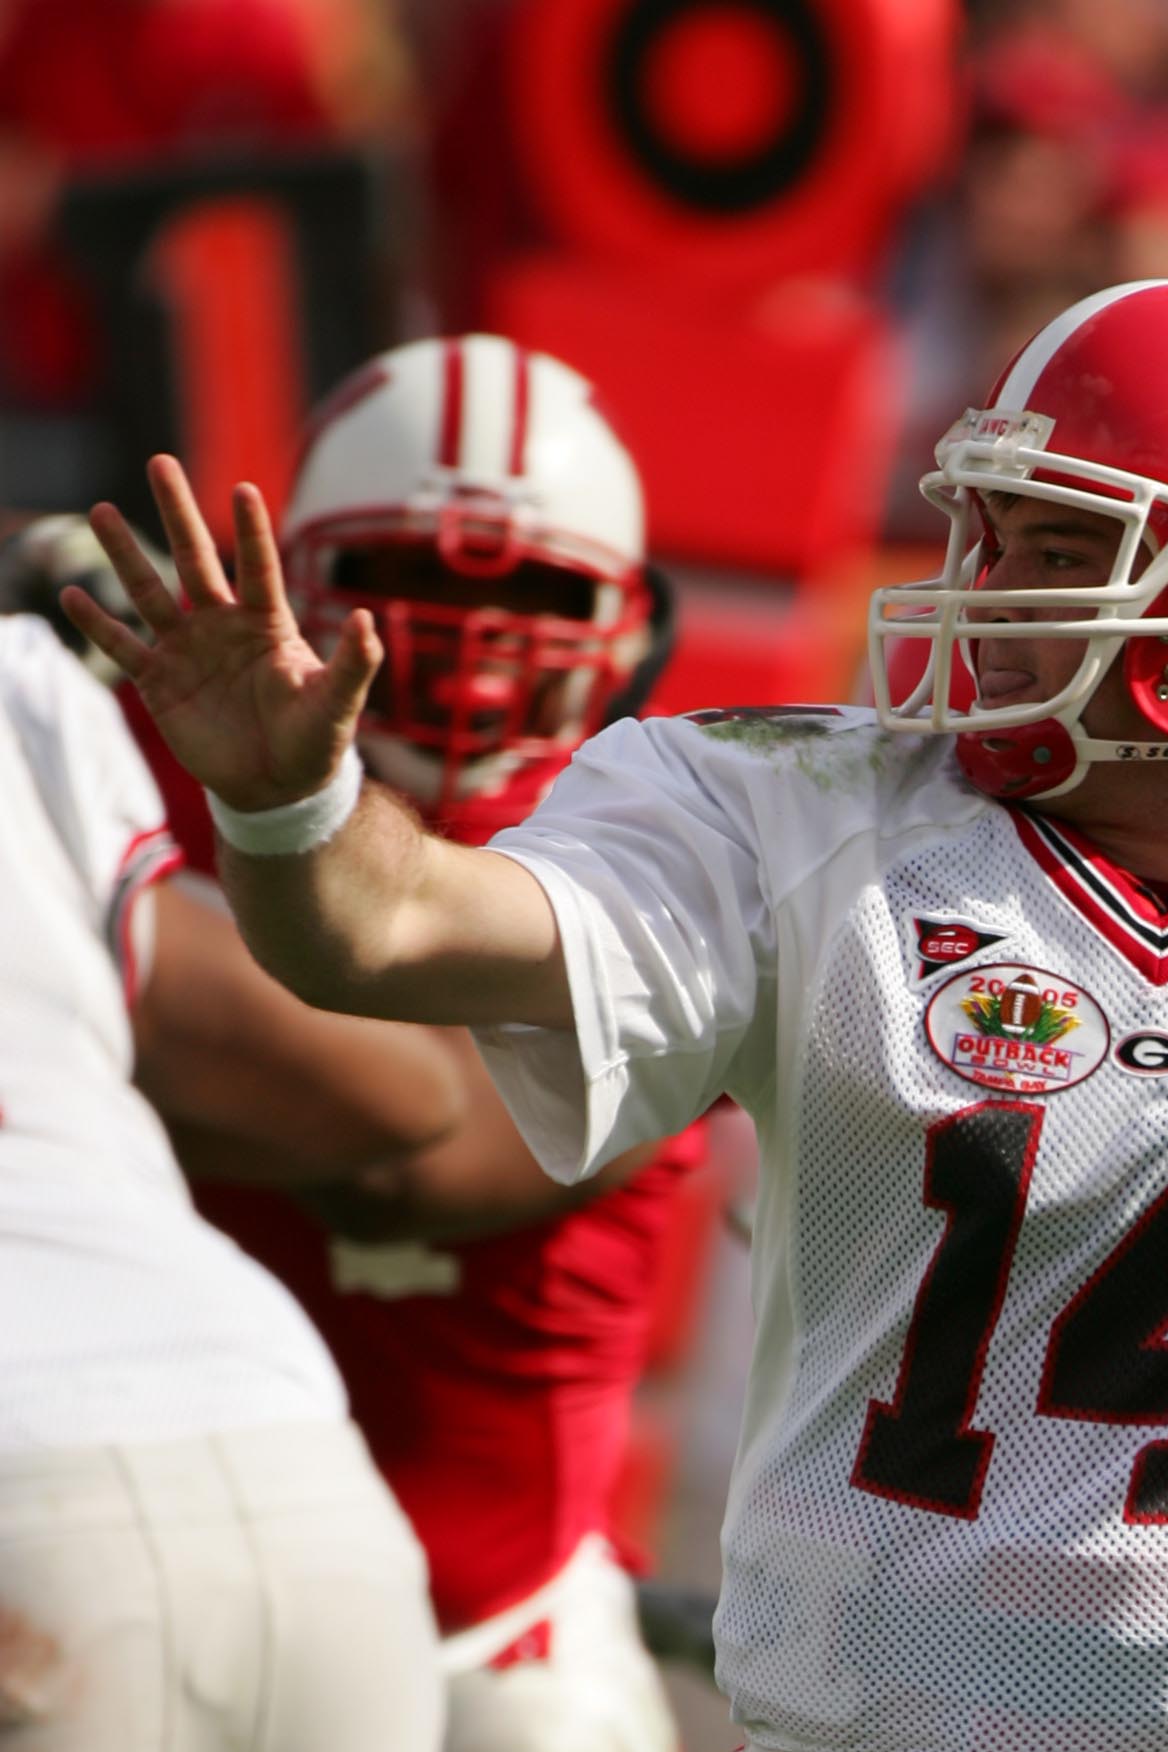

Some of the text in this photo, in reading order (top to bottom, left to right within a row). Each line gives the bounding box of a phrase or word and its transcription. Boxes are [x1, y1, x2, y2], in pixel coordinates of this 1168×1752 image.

[927, 940, 969, 954] SEC
[957, 1036, 1070, 1068] OUTBACK
[971, 1054, 1055, 1077] BOWL
